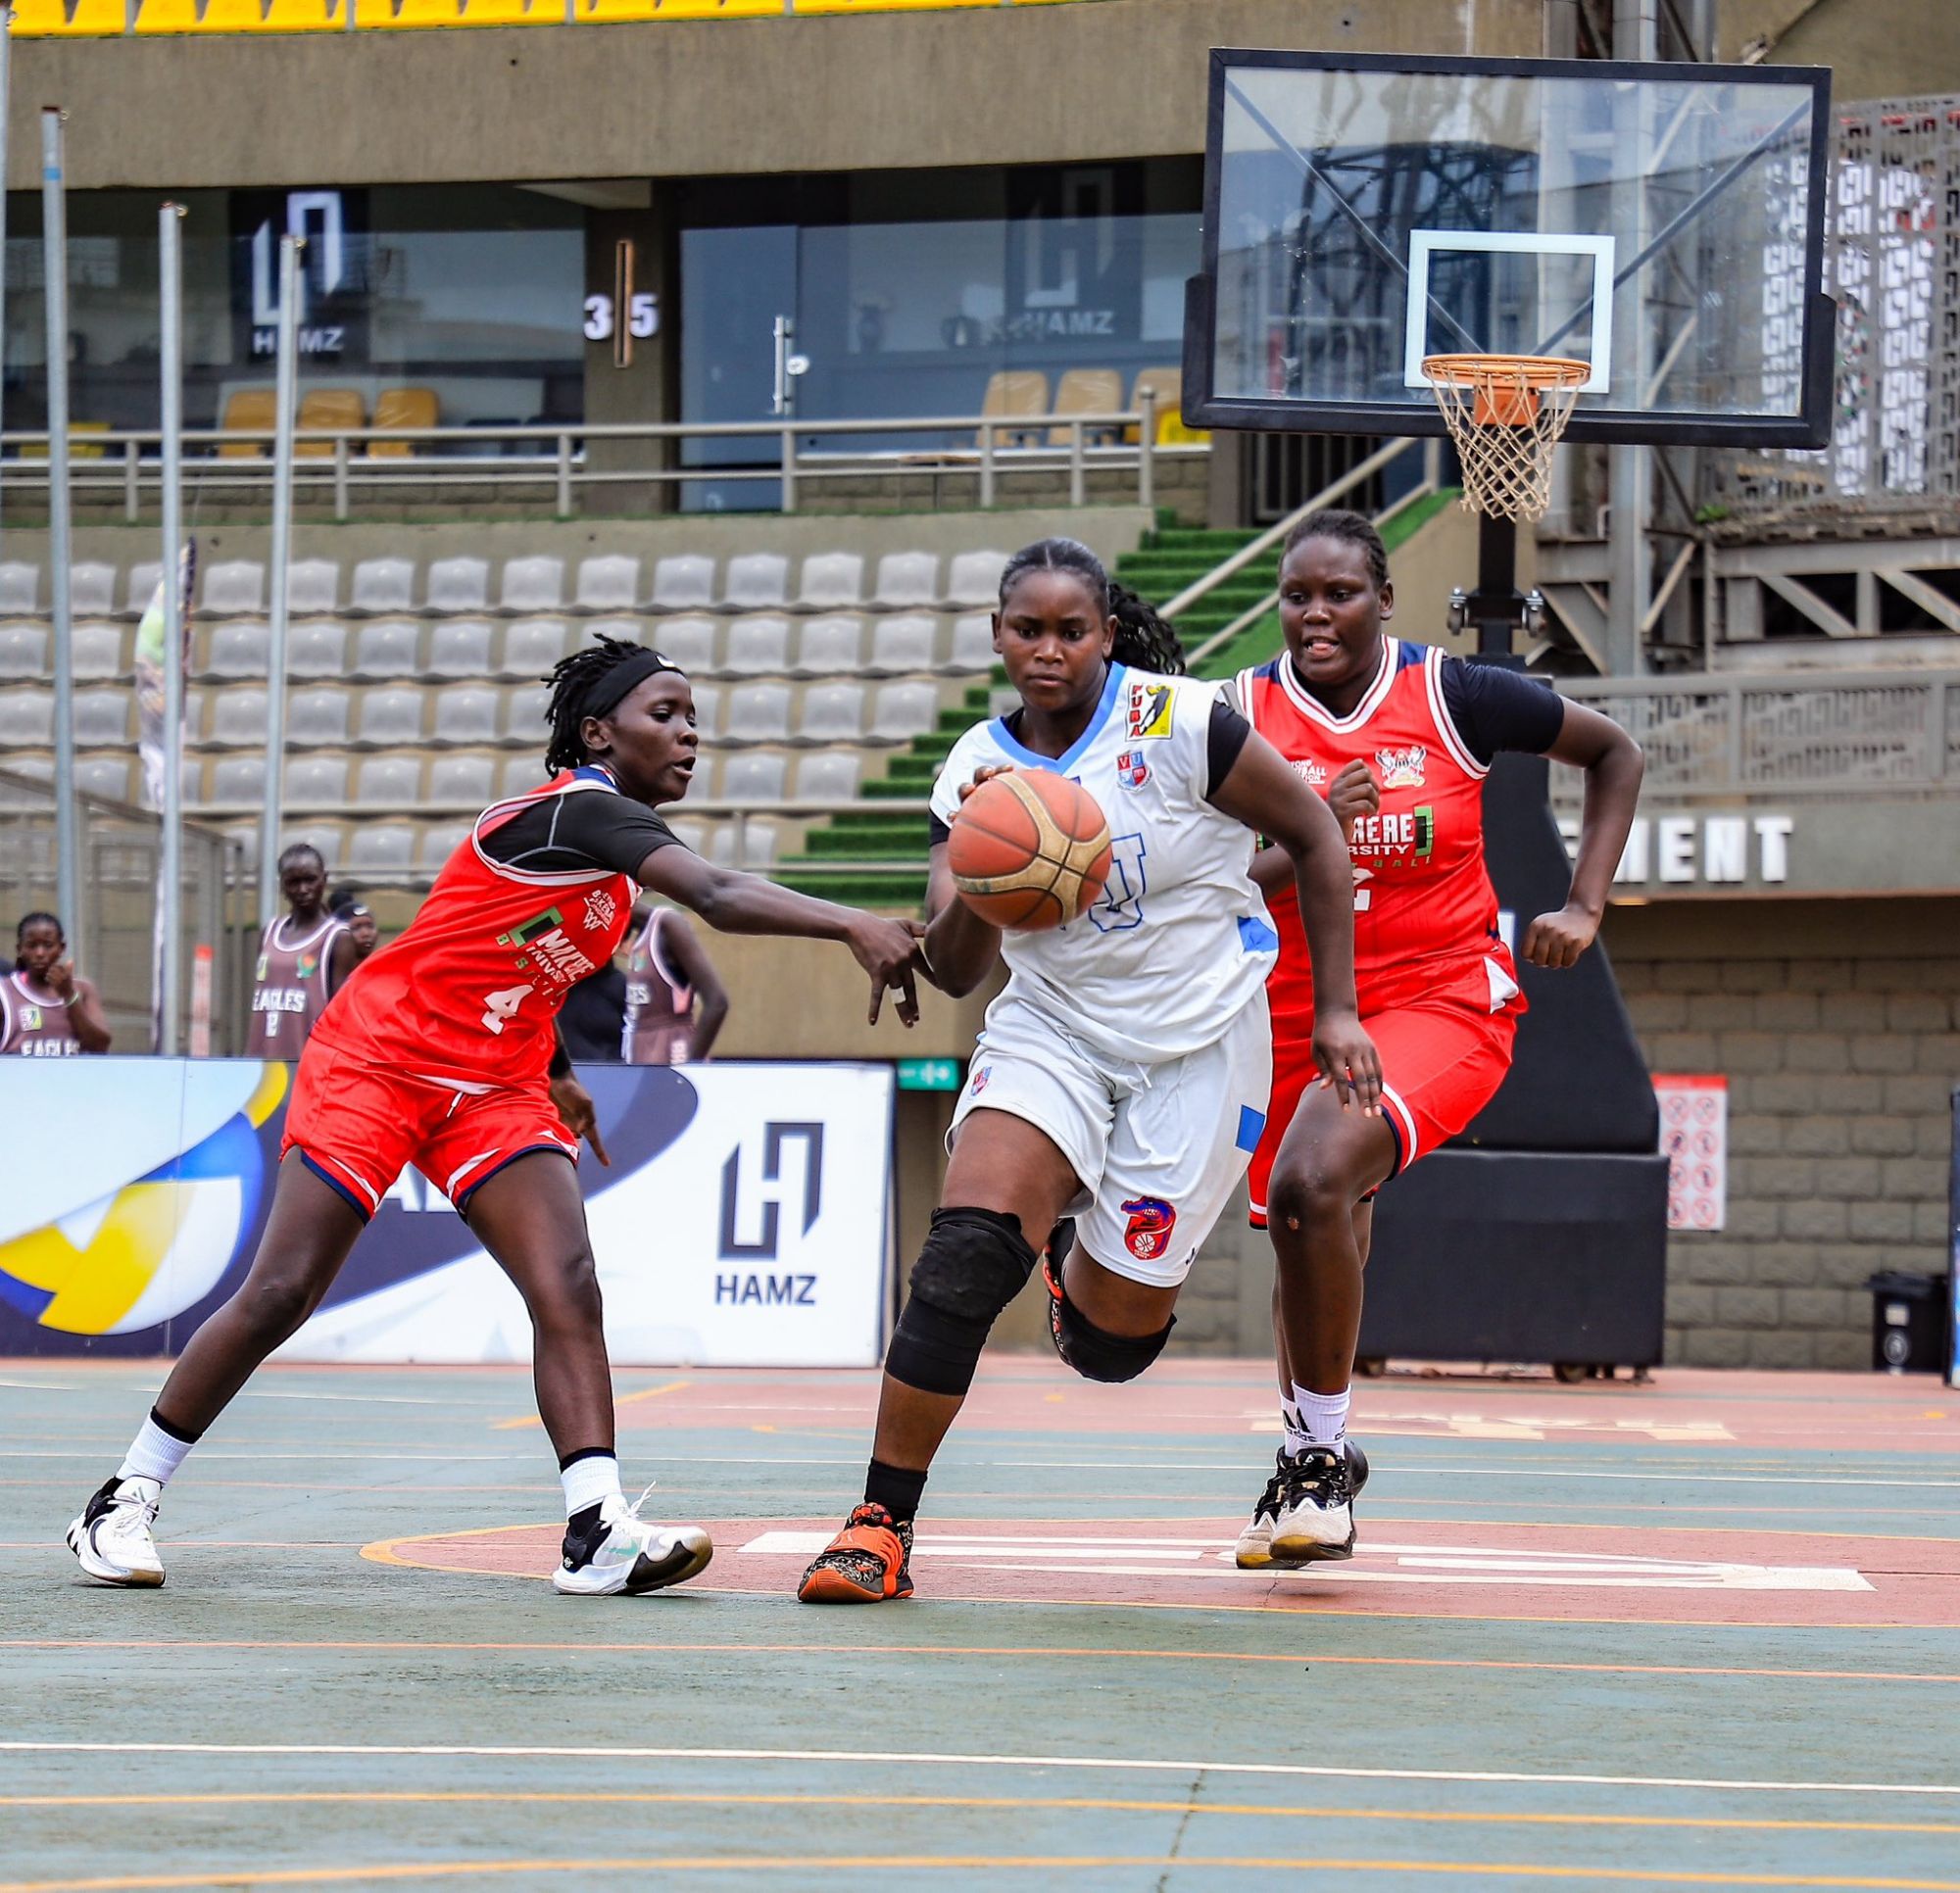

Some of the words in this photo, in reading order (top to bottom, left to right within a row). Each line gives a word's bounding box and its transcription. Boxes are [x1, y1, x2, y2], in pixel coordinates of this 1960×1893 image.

[253, 326, 344, 354] HMZ
[1348, 845, 1409, 855] RSITY
[252, 988, 306, 1013] EAGLES
[481, 985, 534, 1036] 4
[714, 1275, 817, 1305] HAMZ
